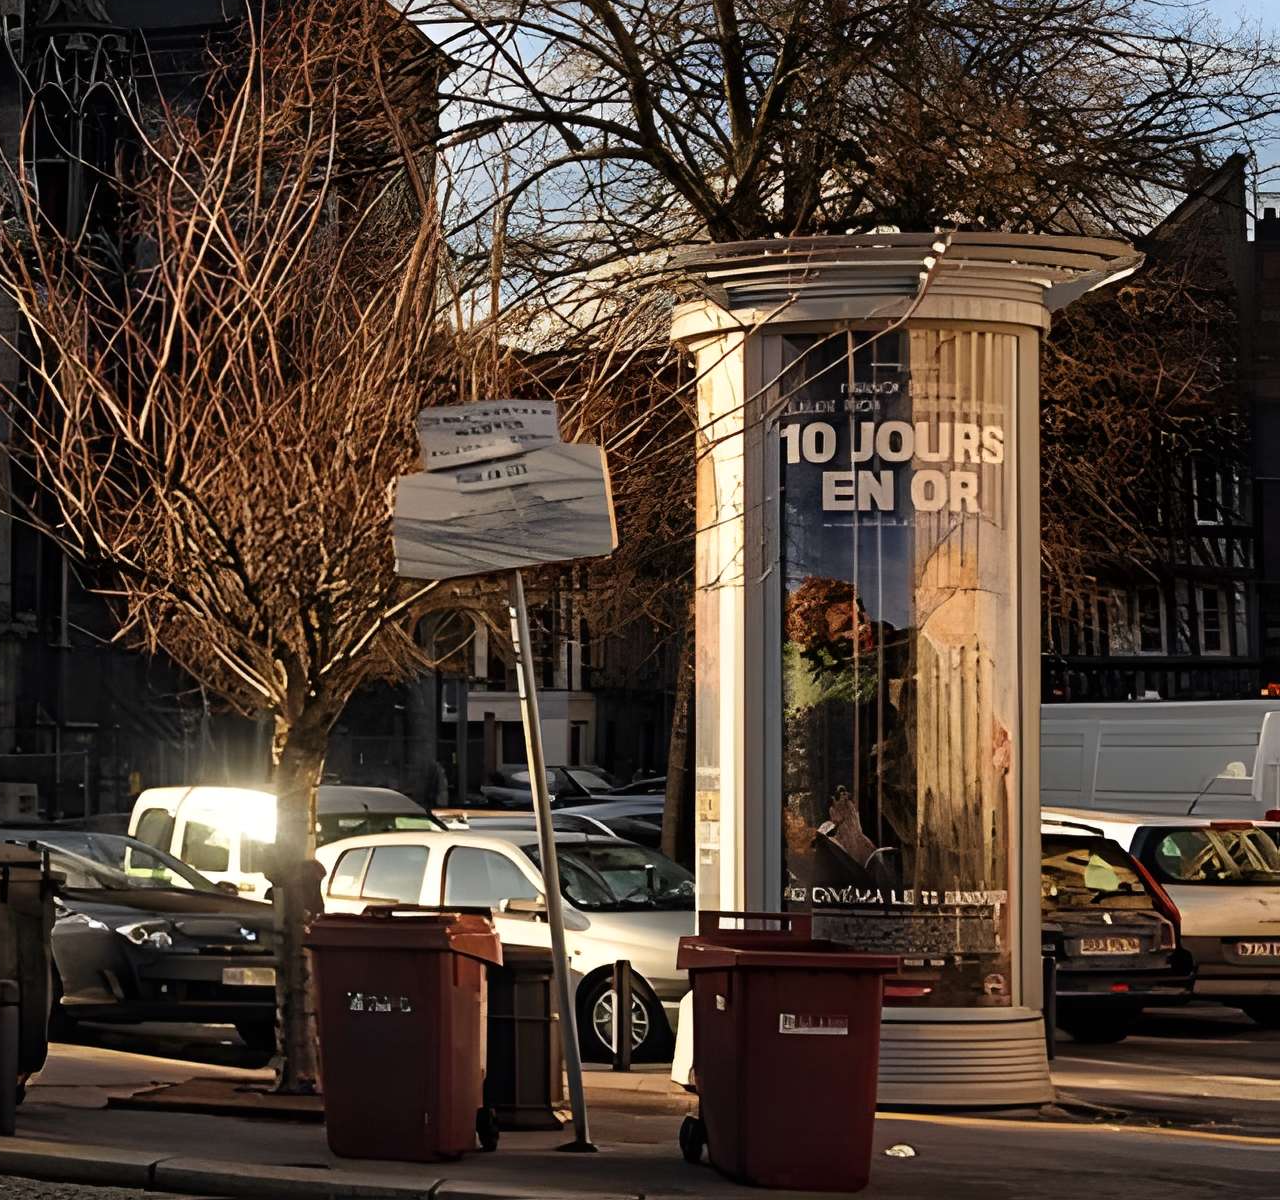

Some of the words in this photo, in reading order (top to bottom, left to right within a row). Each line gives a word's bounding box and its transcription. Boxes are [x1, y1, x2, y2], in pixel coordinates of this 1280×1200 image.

[780, 421, 836, 464] 10
[851, 420, 1004, 464] JOURS
[822, 470, 894, 512] EN
[910, 469, 981, 512] OR
